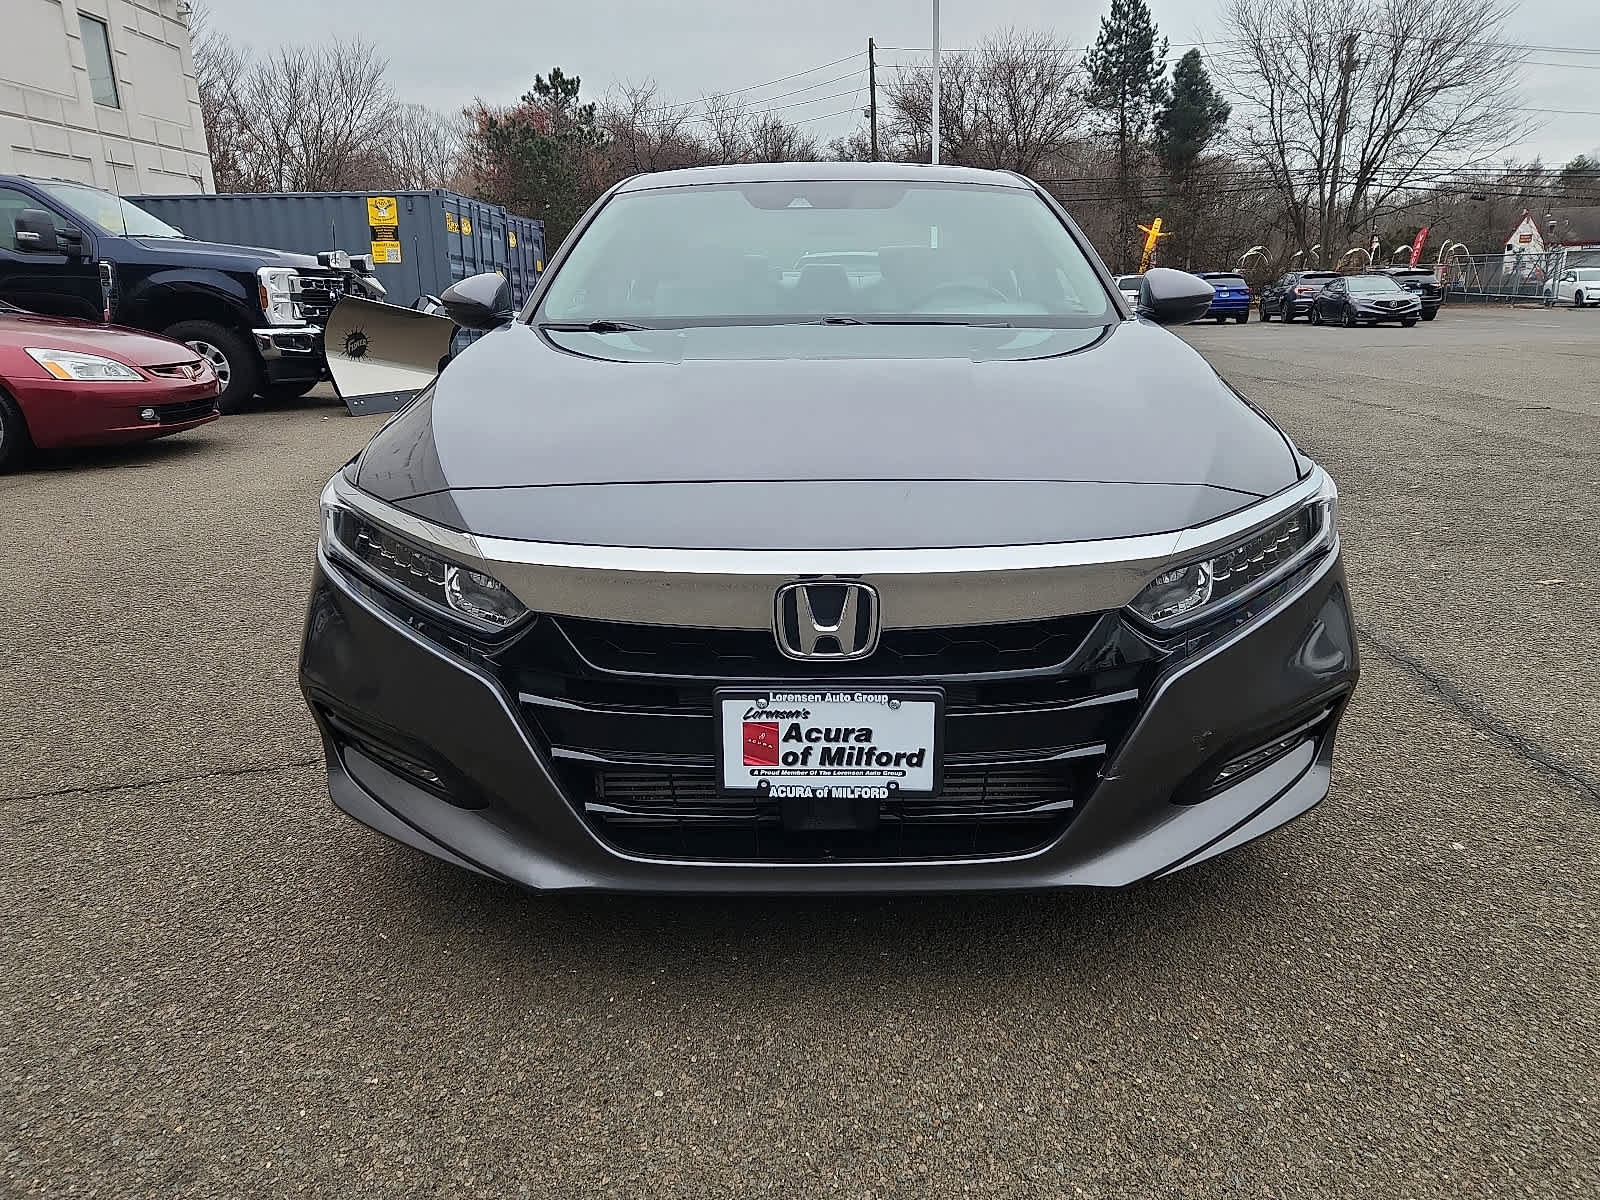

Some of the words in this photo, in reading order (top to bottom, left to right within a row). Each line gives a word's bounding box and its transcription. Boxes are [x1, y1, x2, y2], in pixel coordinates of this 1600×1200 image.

[769, 692, 822, 703] Lorensen
[825, 692, 851, 703] Auto
[854, 692, 889, 705] Group
[742, 707, 811, 720] Lorensen's
[781, 722, 873, 743] Acura
[781, 745, 813, 766] of
[819, 746, 927, 768] Milford
[769, 786, 813, 797] ACURA
[816, 786, 829, 798] of
[832, 787, 889, 798] MILFORD
